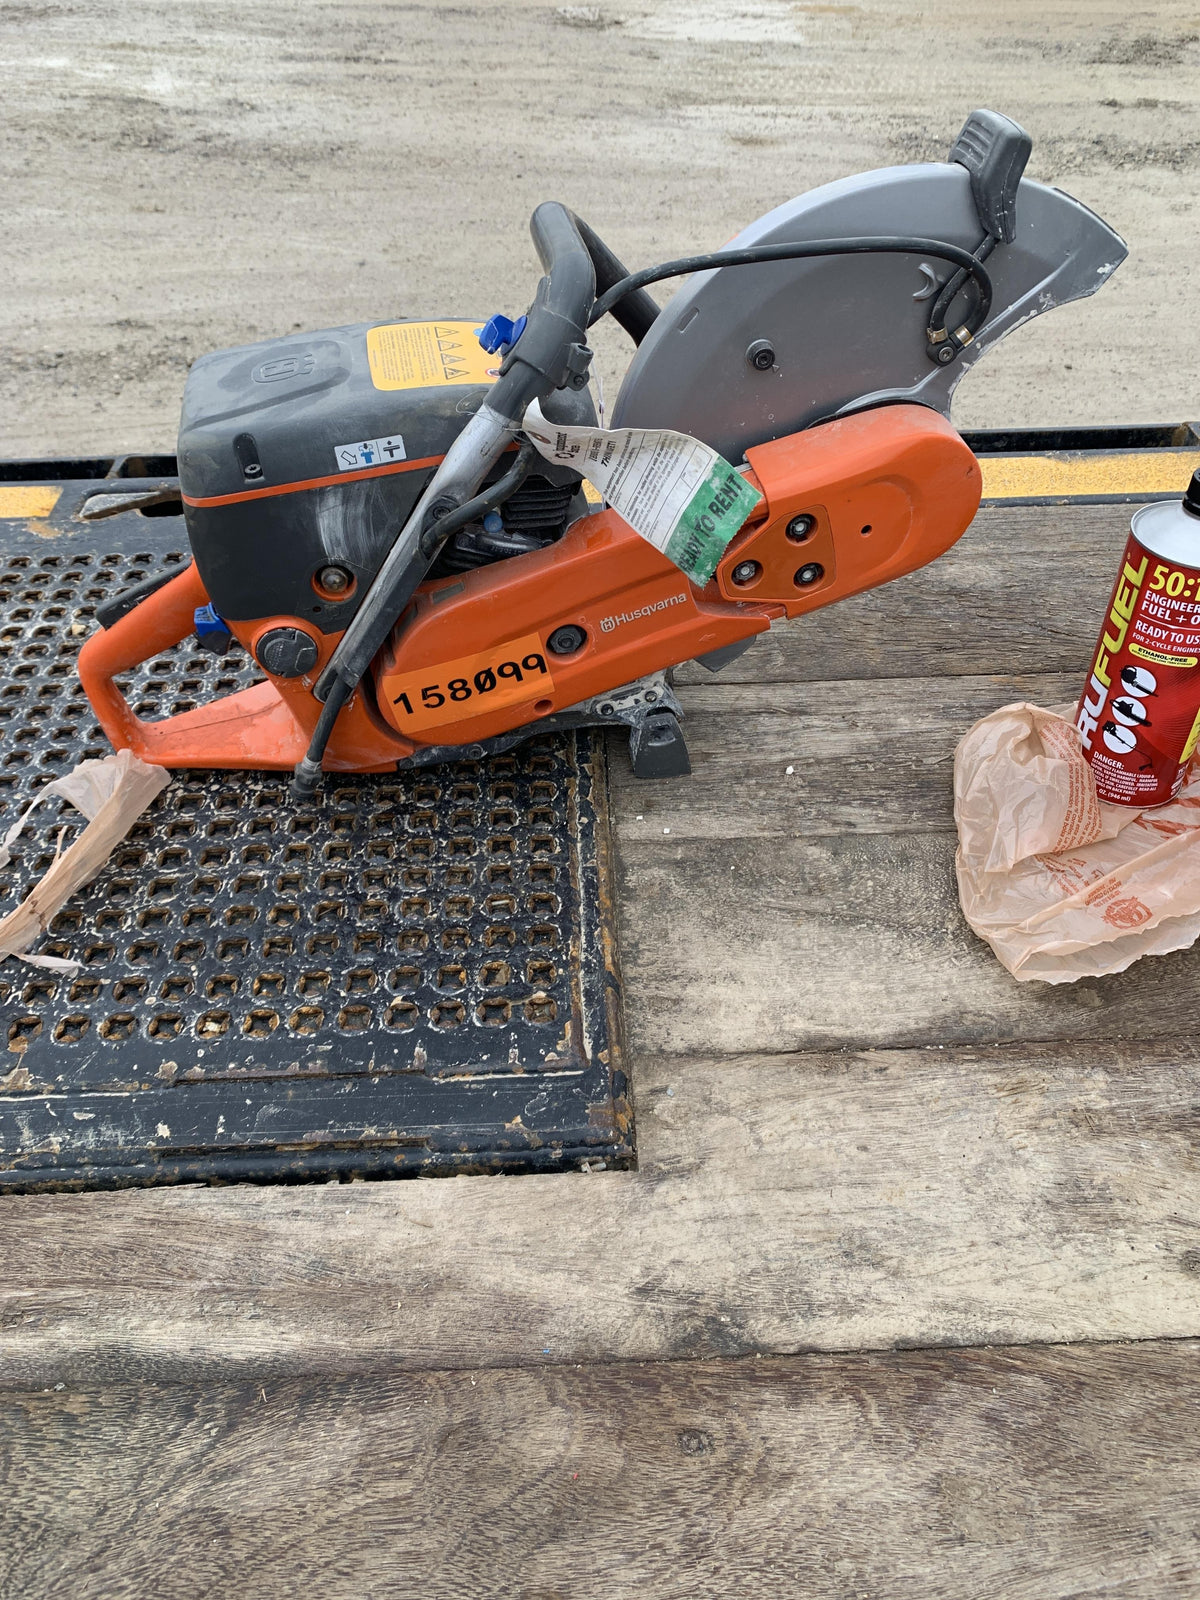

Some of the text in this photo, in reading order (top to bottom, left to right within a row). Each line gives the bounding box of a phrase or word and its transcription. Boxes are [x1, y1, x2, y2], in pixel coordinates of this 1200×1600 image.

[679, 473, 743, 573] READY TO RENT
[615, 593, 687, 626] Husqvarna
[1141, 600, 1171, 620] FUEL
[1132, 632, 1144, 642] FOR
[1145, 638, 1171, 650] 2-CYCLE
[1135, 620, 1169, 640] READY
[1170, 632, 1184, 643] TO
[1077, 556, 1149, 750] RUFUEL
[1138, 647, 1188, 662] ETHANOL-FREE
[1093, 751, 1124, 770] DANGER:
